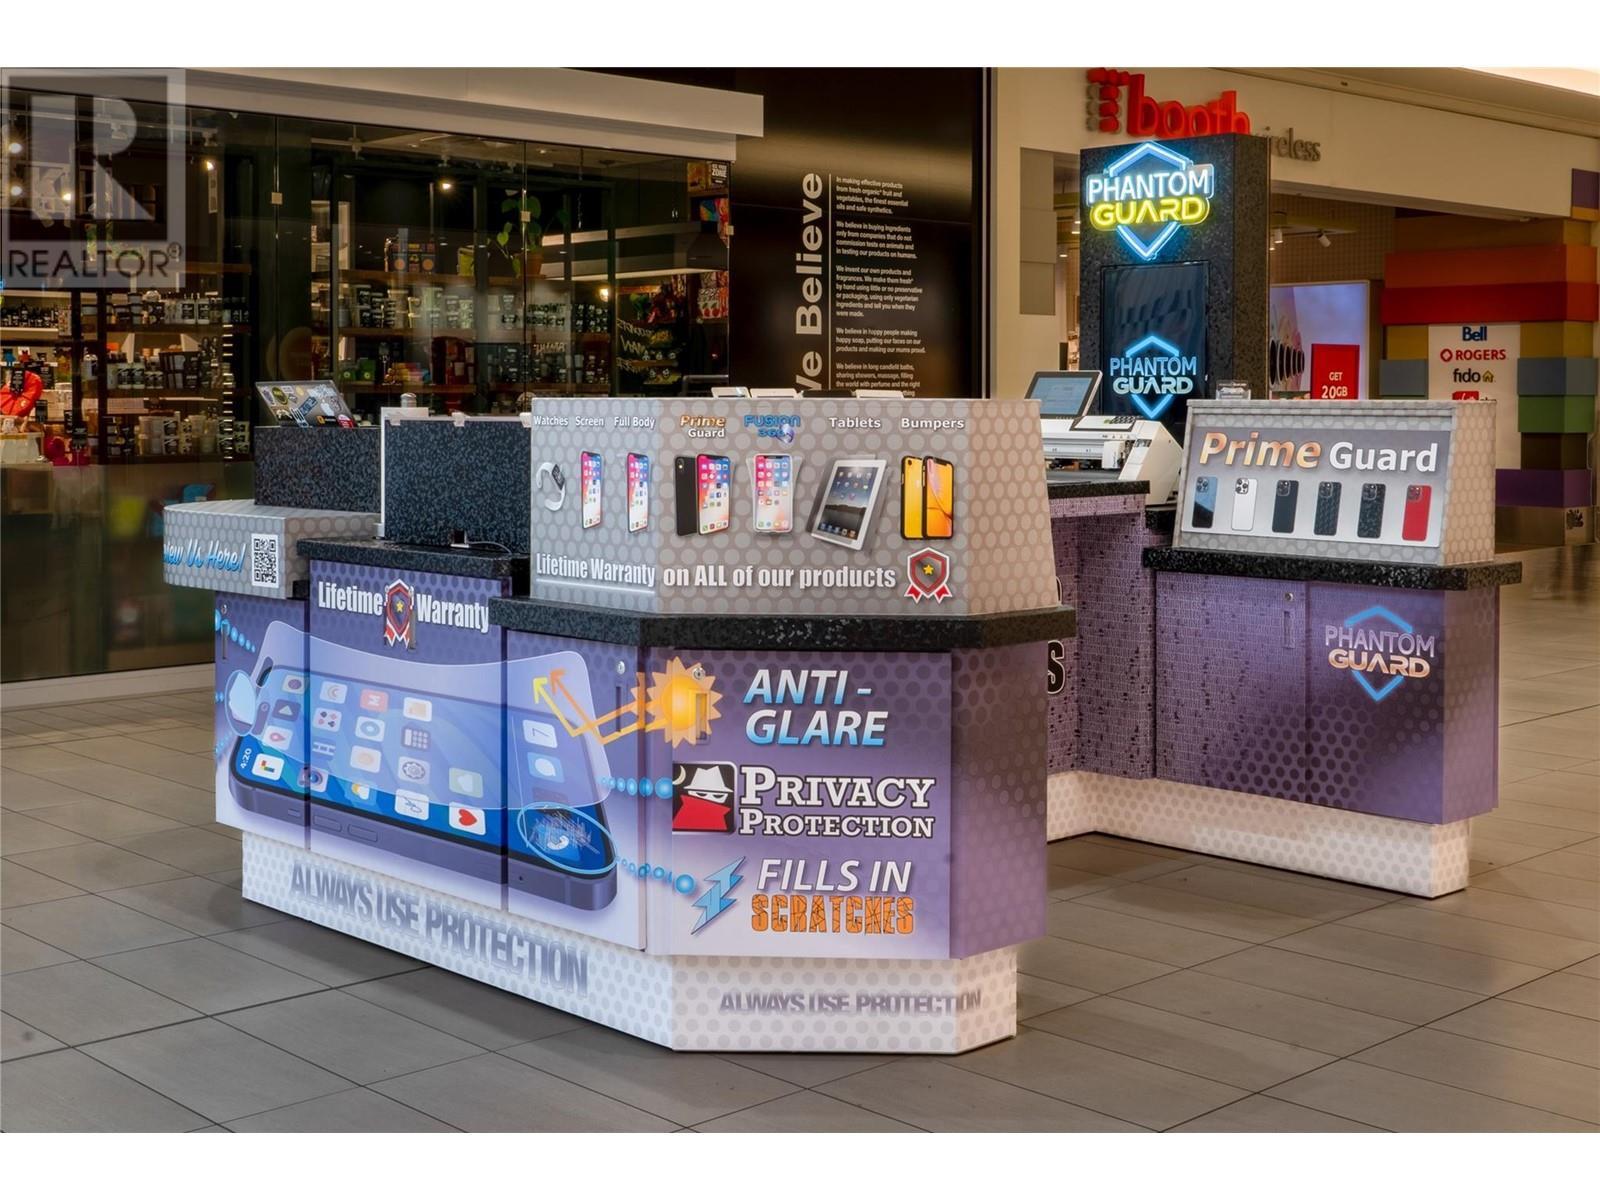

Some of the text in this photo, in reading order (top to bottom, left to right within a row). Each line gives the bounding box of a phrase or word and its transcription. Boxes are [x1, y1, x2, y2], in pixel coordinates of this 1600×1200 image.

[1087, 168, 1210, 205] PHANTOM
[1092, 197, 1206, 227] GUARD
[796, 173, 823, 334] Believe
[1462, 326, 1487, 342] Bell
[1109, 356, 1197, 377] PHANTOM
[1455, 348, 1507, 361] ROGERS
[1112, 376, 1194, 395] GUARD
[1329, 372, 1343, 382] GET
[1453, 368, 1481, 383] fido
[533, 416, 569, 427] Watches
[575, 416, 604, 427] Screen
[614, 417, 655, 429] Full Body
[680, 415, 726, 428] Prime
[688, 428, 725, 439] Guard
[829, 417, 881, 429] Tablets
[901, 417, 965, 430] Bumpers
[1199, 431, 1438, 472] Prime Guard
[187, 538, 203, 568] Us
[207, 543, 246, 573] Here!
[536, 553, 896, 589] Lifetime Warranty on ALL of our products
[318, 581, 489, 633] Lifetime Warranty
[1325, 624, 1435, 658] PHANTOM
[1328, 648, 1431, 678] GUARD
[745, 710, 889, 746] GLARE
[740, 765, 936, 808] PRIVACY
[739, 808, 935, 838] PROTECTION
[758, 859, 912, 893] FILLS IN
[751, 895, 914, 934] SCRATCHES
[291, 862, 589, 999] ALWAYS USE PROTECTION
[719, 989, 981, 1017] ALWAYS USE PROTECTION
